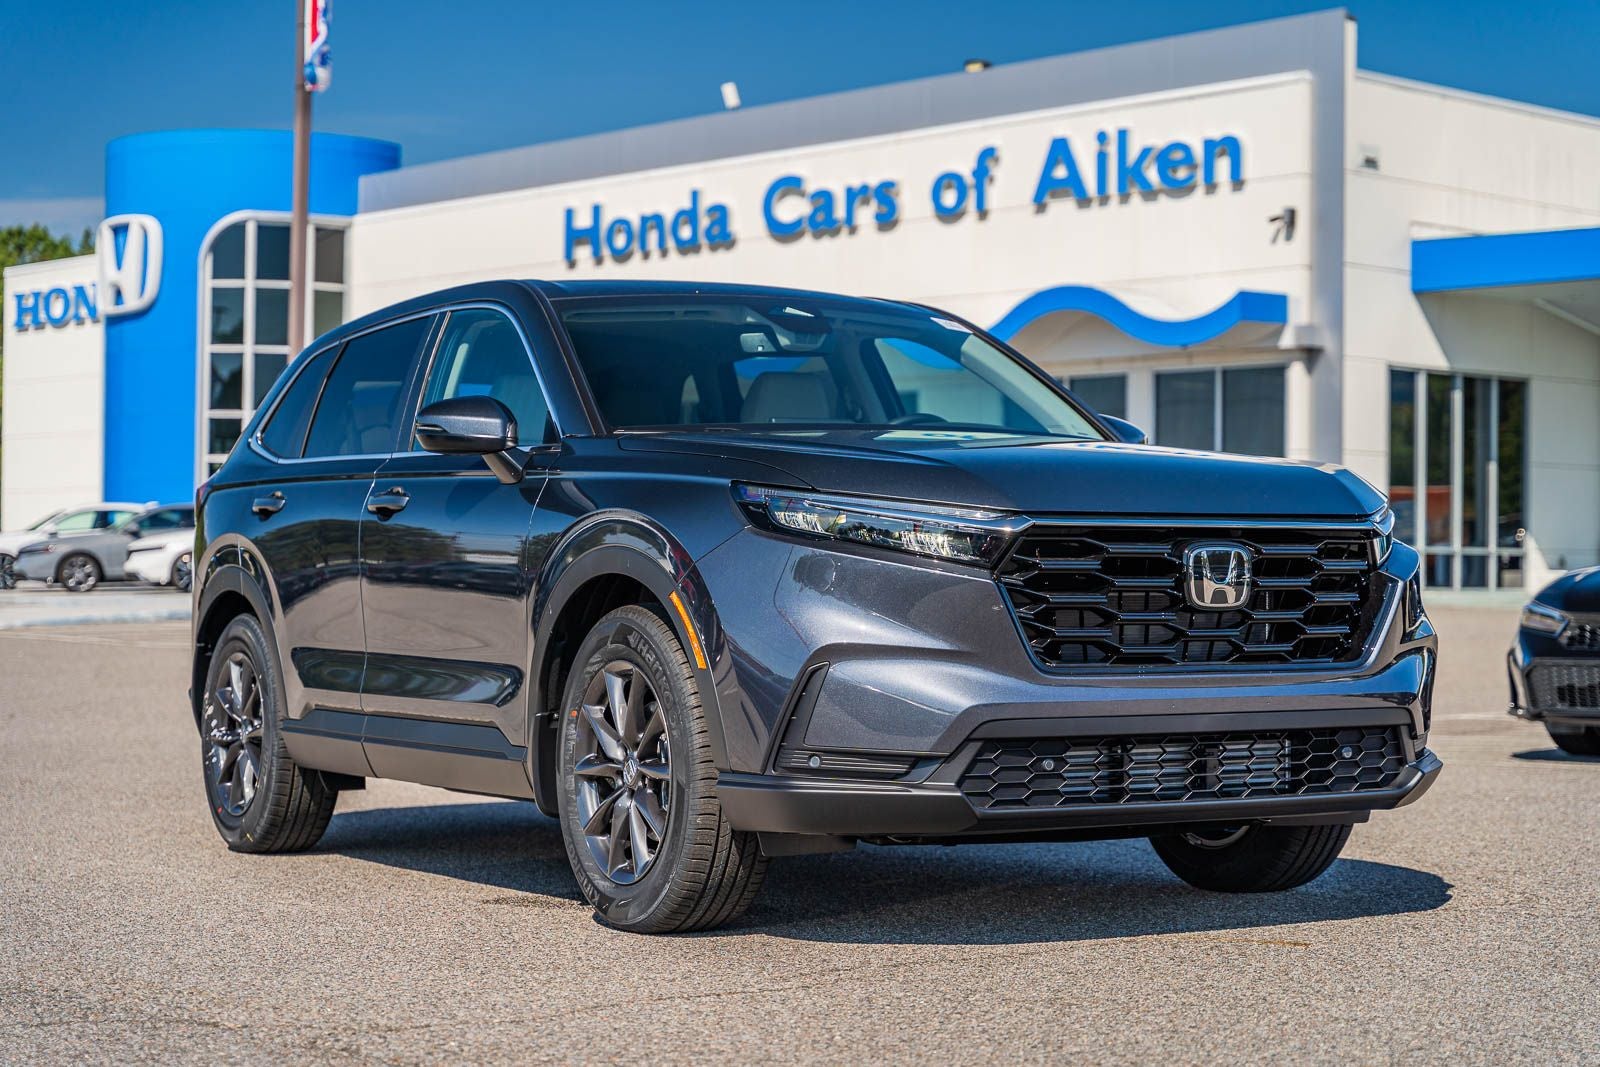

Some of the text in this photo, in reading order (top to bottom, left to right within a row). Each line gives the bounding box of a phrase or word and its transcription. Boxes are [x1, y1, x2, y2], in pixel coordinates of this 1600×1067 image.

[563, 128, 1243, 263] Honda Cars of Aiken
